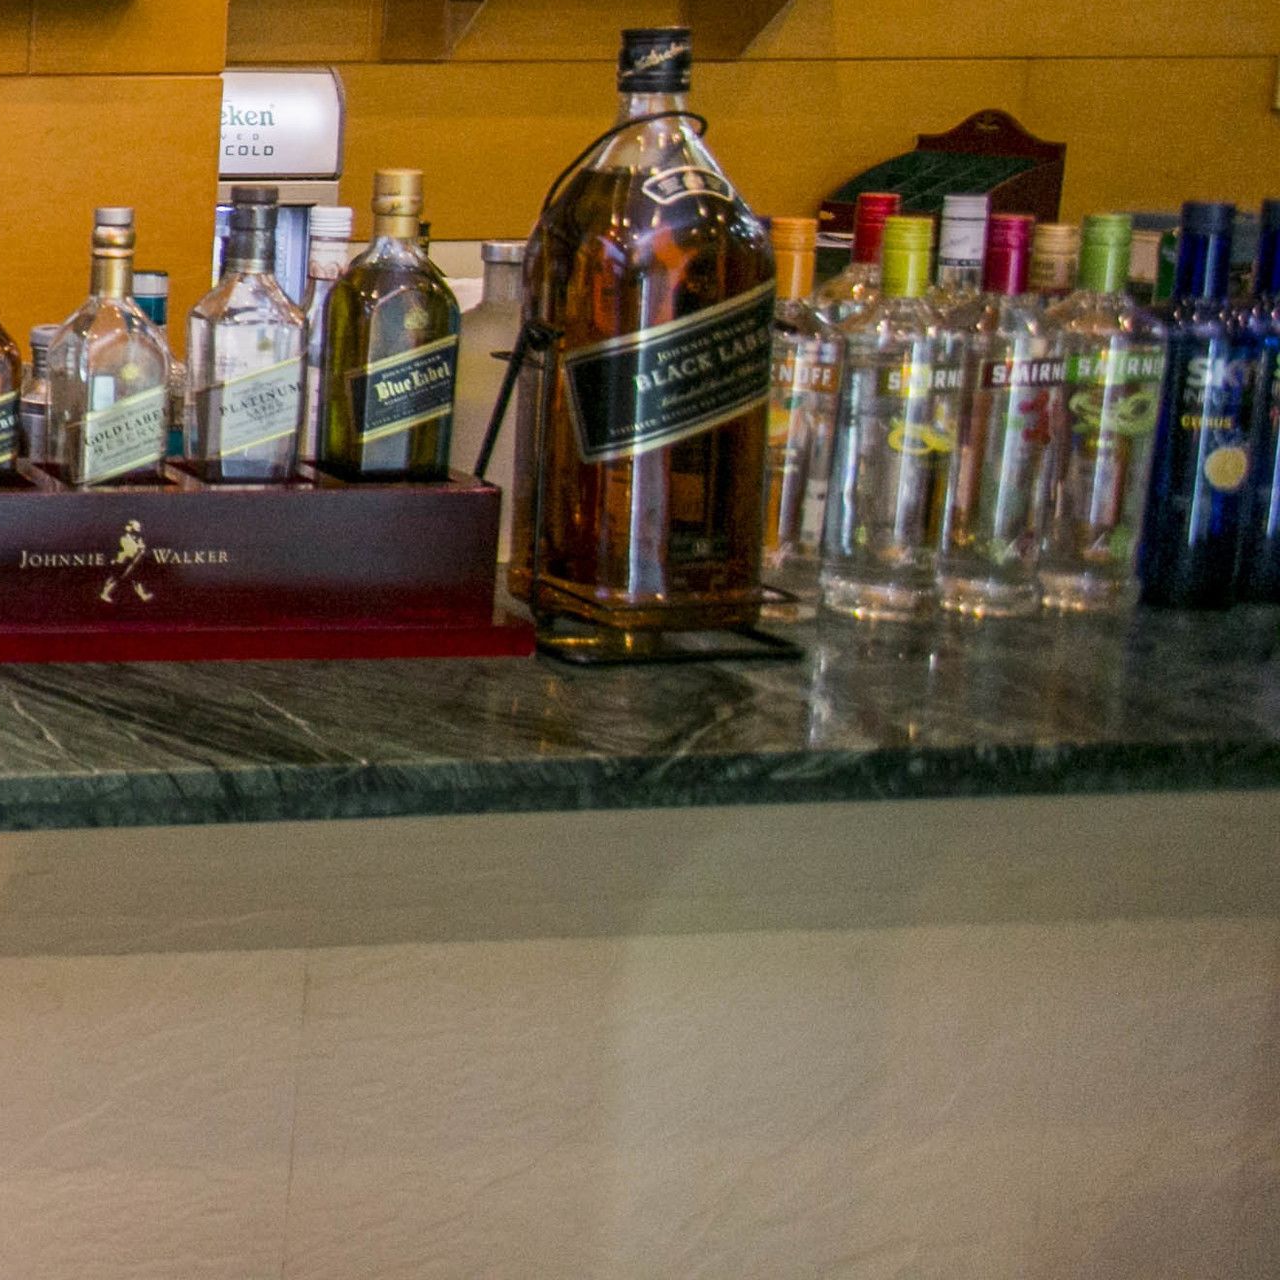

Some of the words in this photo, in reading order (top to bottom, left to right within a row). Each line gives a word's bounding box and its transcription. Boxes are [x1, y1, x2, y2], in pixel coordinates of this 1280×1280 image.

[220, 105, 275, 126] eken
[226, 145, 274, 156] COLD
[374, 378, 412, 402] Blue
[410, 362, 451, 388] Label
[635, 351, 714, 392] BLACK
[771, 365, 833, 387] NOFF
[219, 381, 303, 416] PLATINUM
[84, 425, 123, 446] GOLD
[19, 550, 107, 569] JOHNNIE
[152, 548, 229, 565] WALKER
